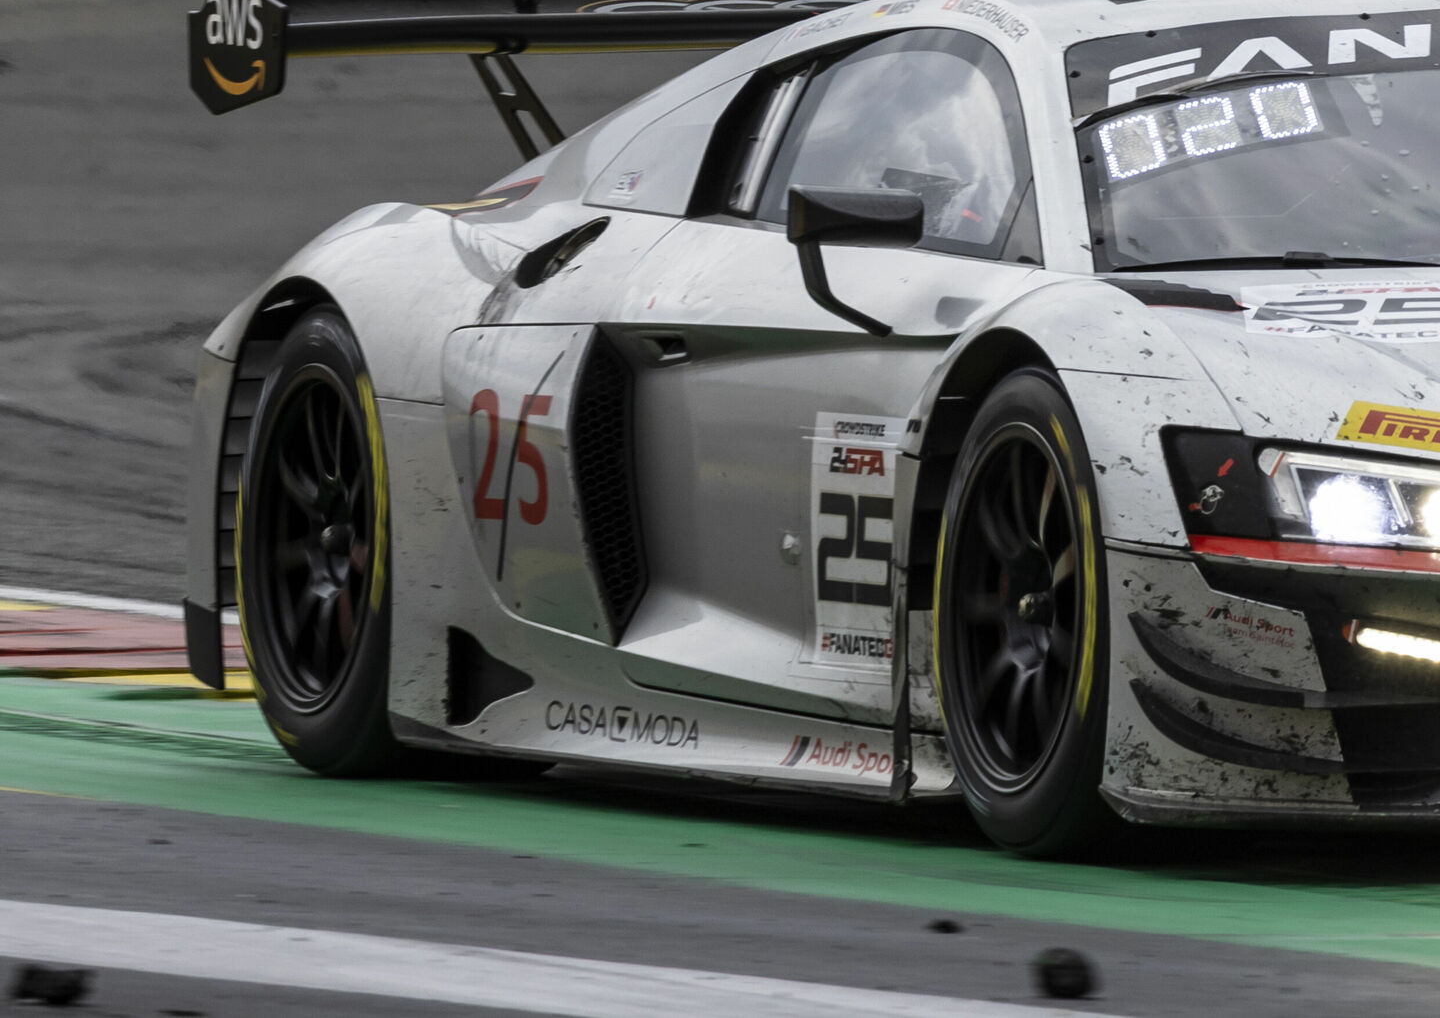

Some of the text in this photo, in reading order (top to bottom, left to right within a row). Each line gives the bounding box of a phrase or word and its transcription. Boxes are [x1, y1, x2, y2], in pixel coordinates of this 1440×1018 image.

[469, 388, 553, 525] 25
[817, 492, 894, 607] 25
[806, 737, 893, 777] Audi Spo
